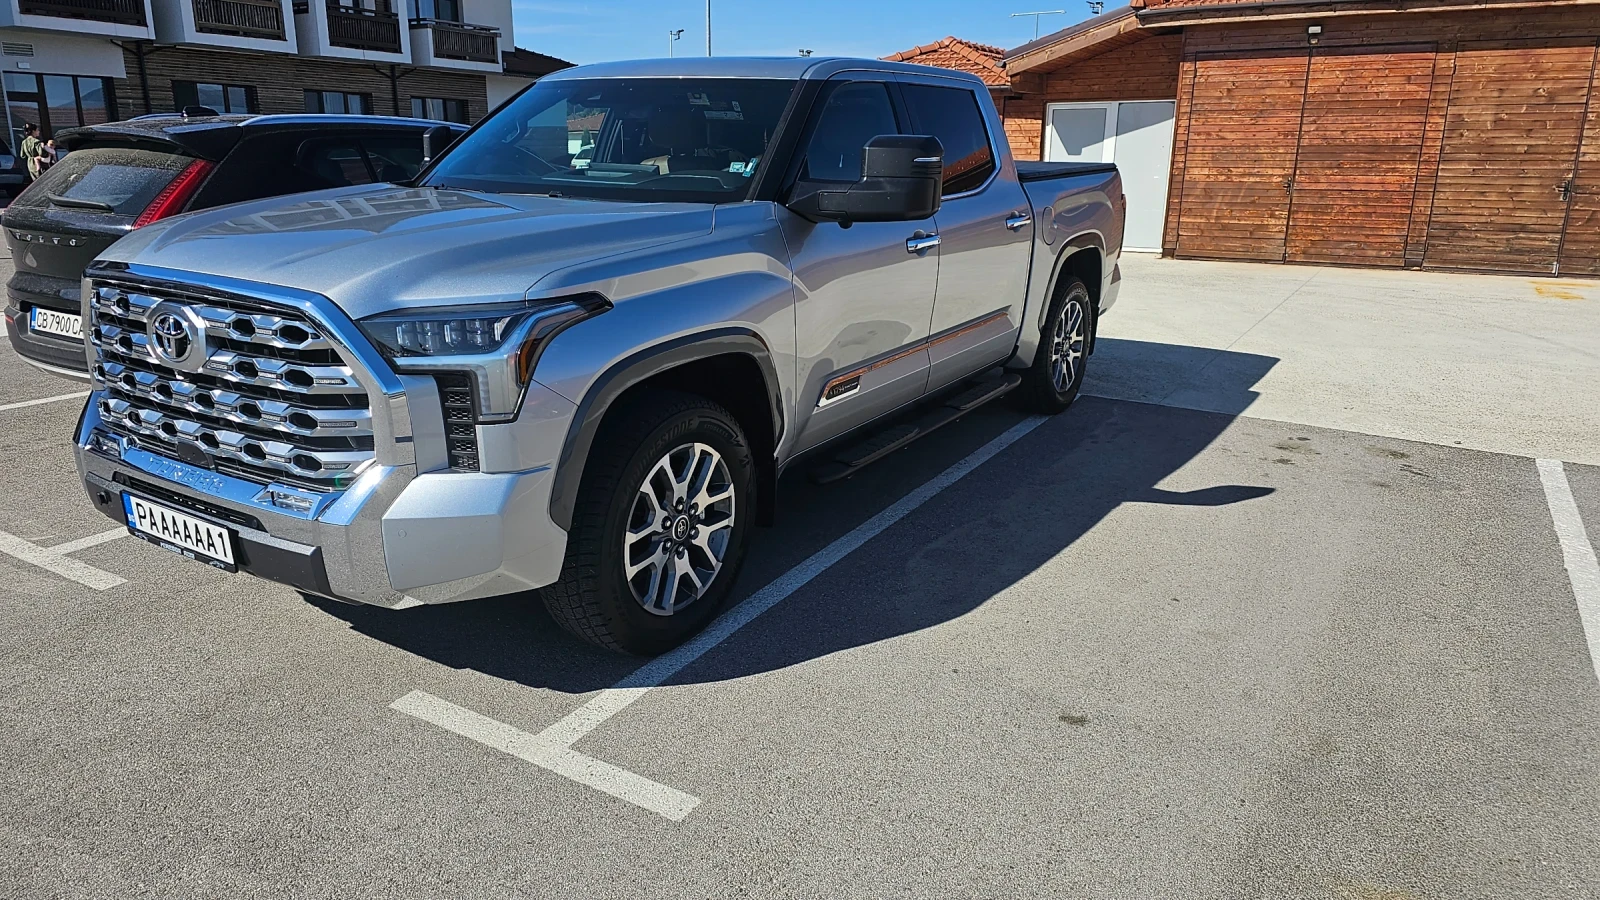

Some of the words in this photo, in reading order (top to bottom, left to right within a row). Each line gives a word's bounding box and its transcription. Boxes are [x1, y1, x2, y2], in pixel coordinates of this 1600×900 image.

[15, 232, 77, 247] VOLVO
[37, 311, 48, 329] CB
[49, 313, 71, 333] 7900
[147, 455, 228, 494] TUNDRA
[135, 501, 228, 559] PAAAAAA1
